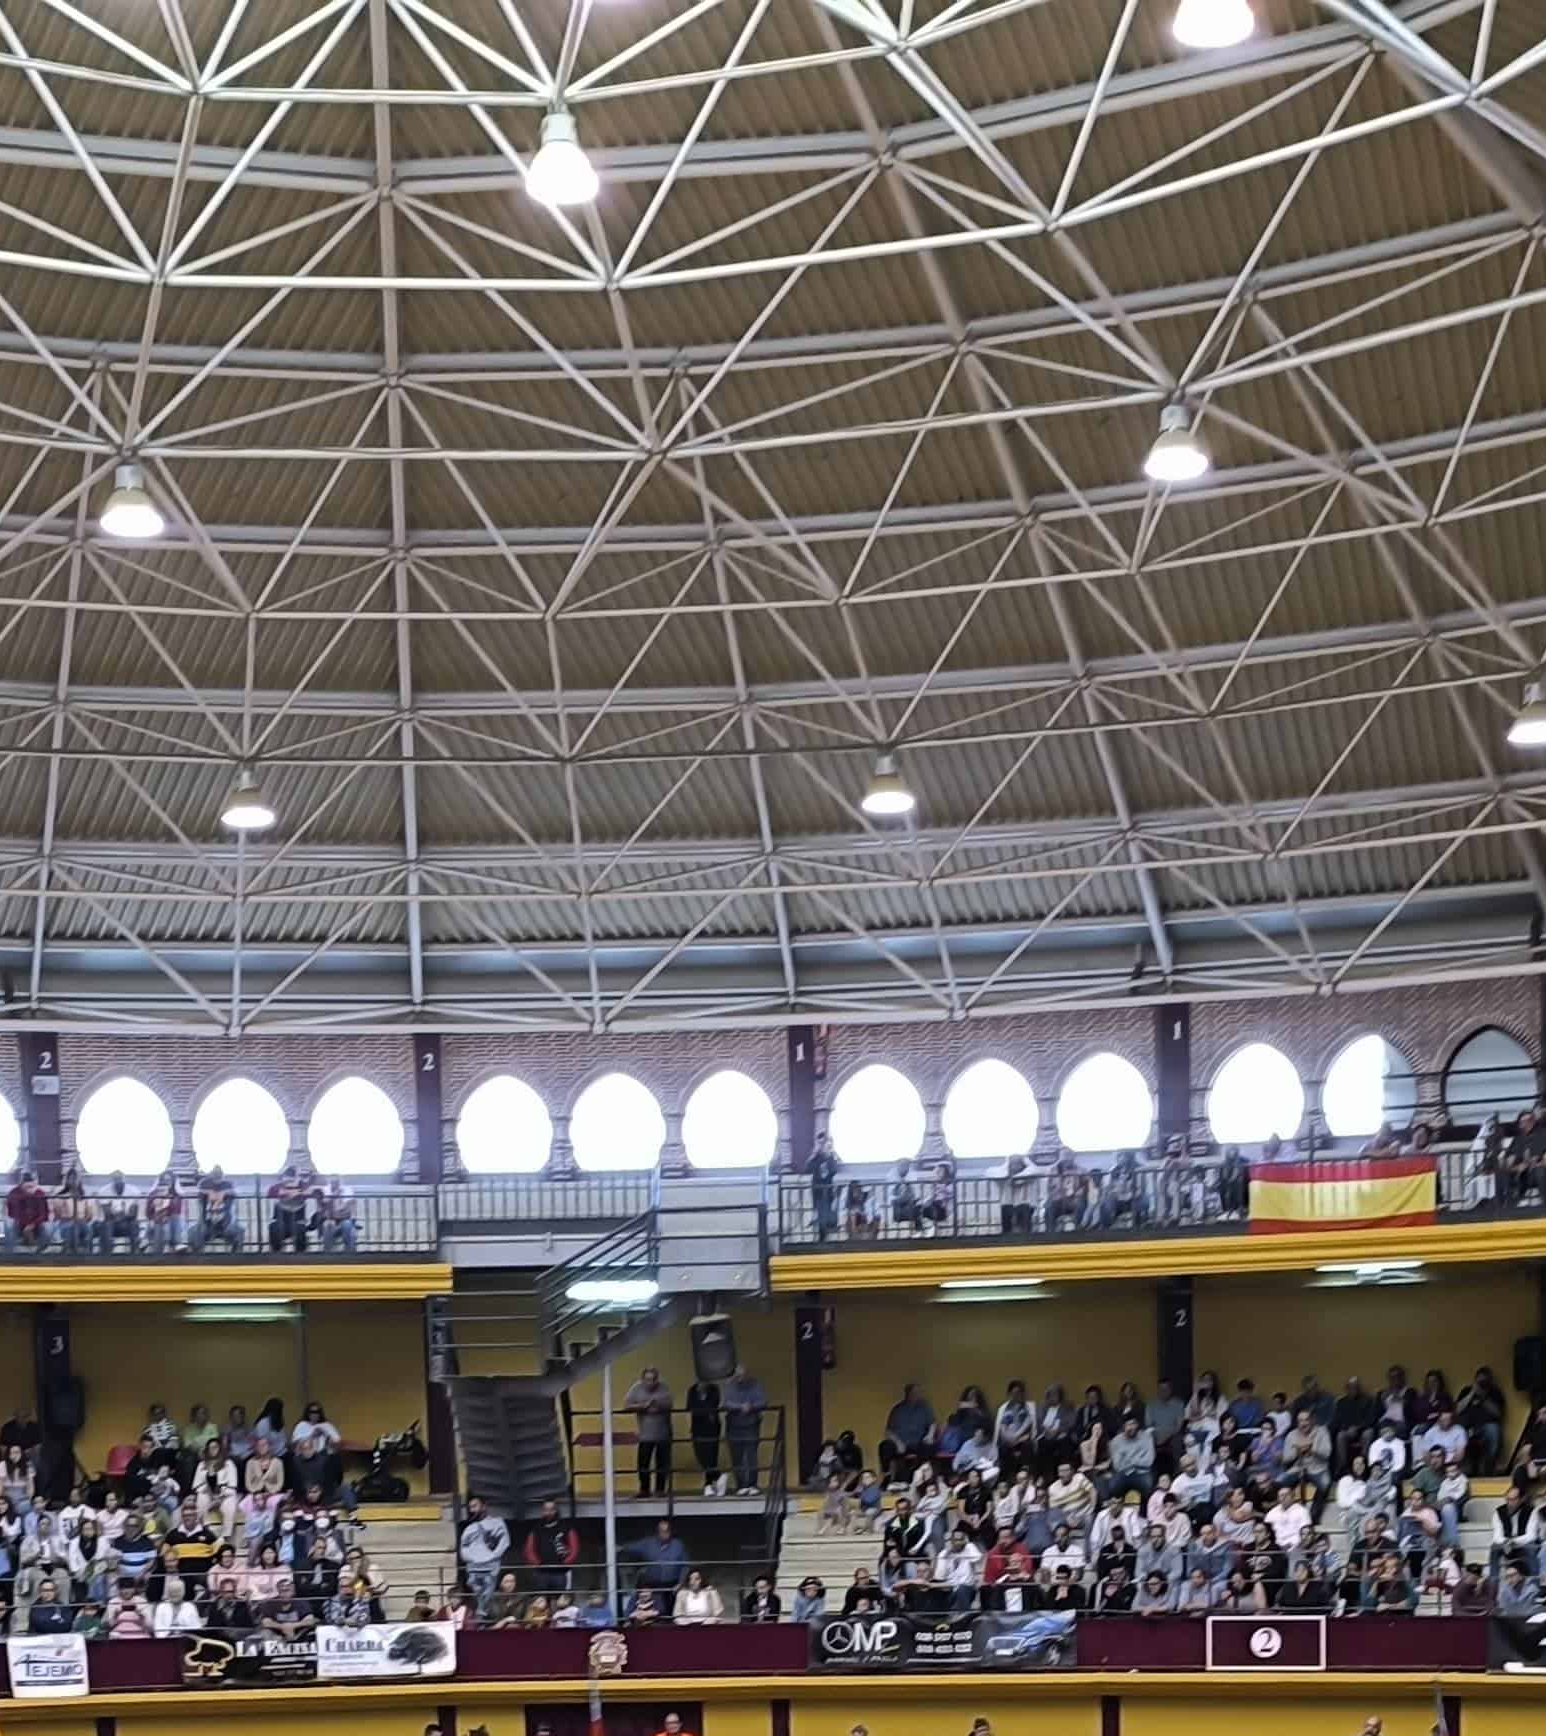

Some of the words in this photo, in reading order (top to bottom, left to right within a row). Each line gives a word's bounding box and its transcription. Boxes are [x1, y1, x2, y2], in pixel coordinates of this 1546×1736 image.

[1172, 1020, 1182, 1041] 1
[38, 1050, 53, 1070] 2
[420, 1052, 436, 1072] 2
[795, 1041, 806, 1062] 1
[1174, 1308, 1188, 1328] 2
[801, 1320, 814, 1341] 2
[50, 1335, 64, 1355] 3
[1259, 1629, 1274, 1653] 2
[23, 1654, 84, 1678] TEJEMO
